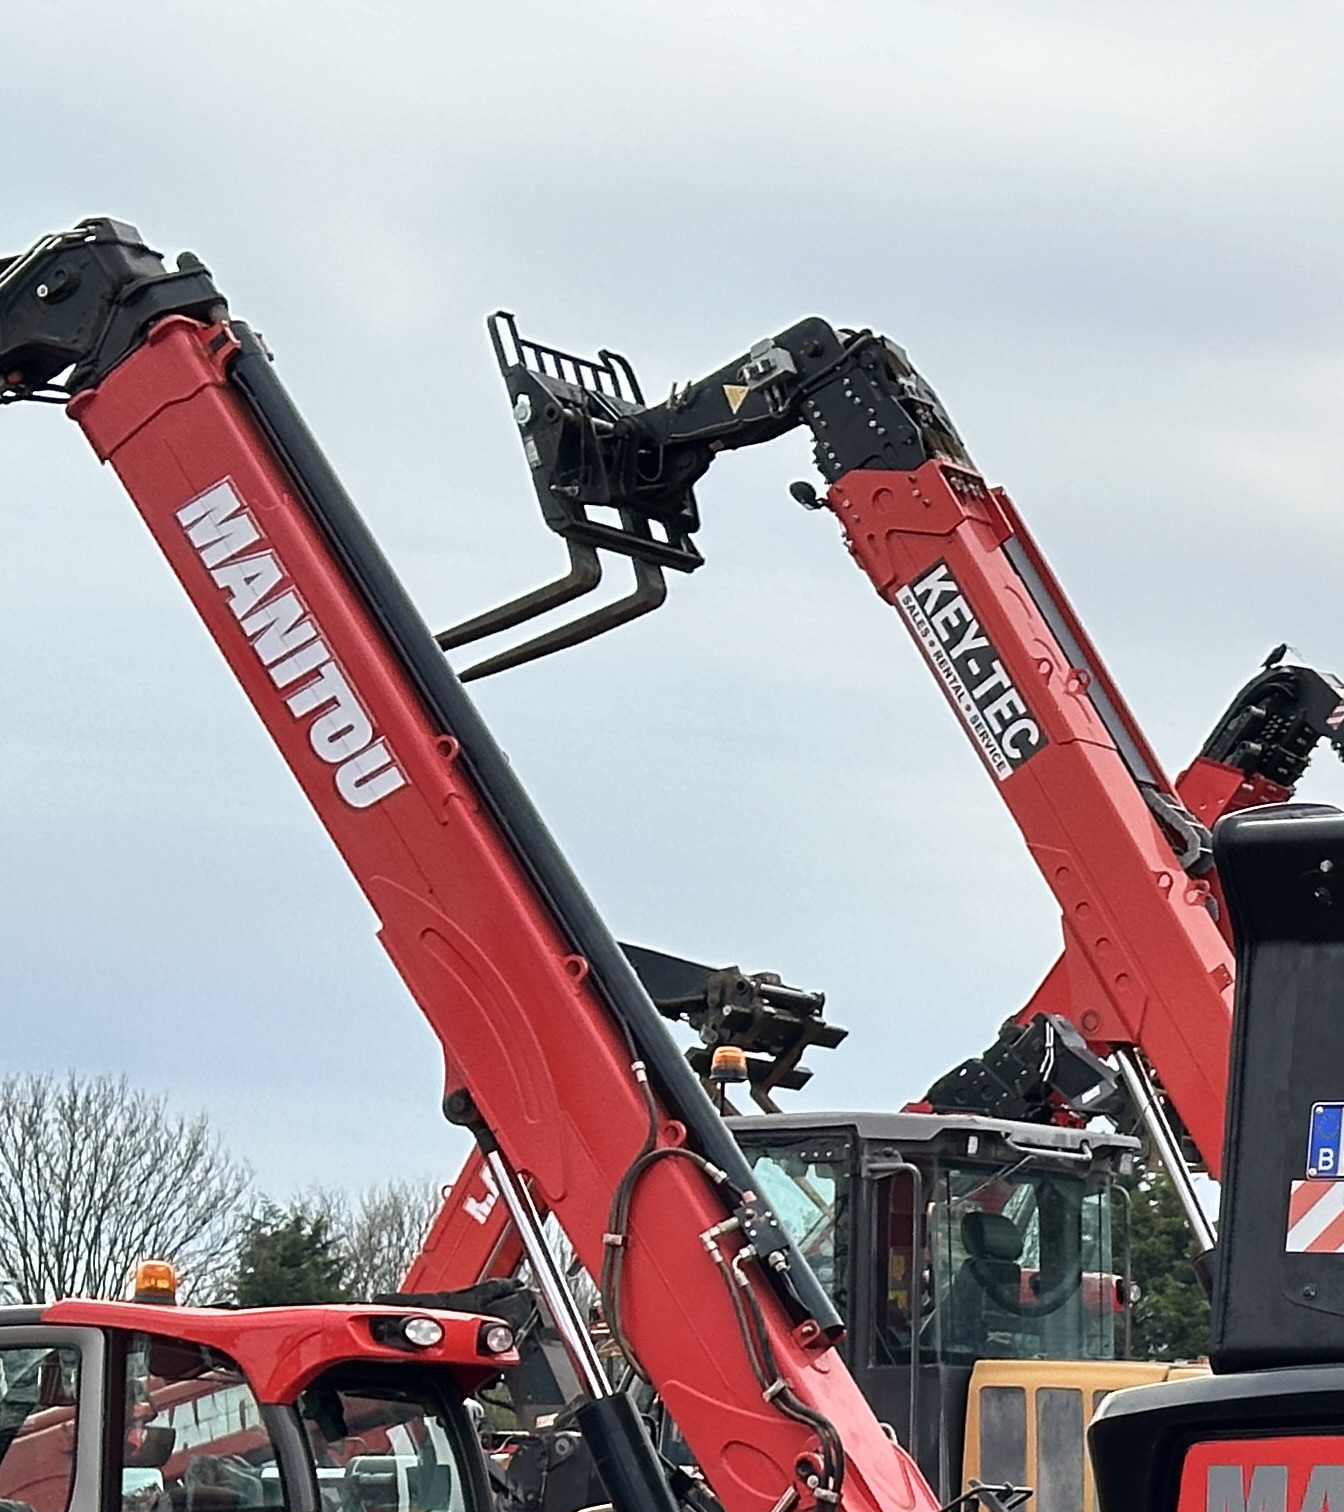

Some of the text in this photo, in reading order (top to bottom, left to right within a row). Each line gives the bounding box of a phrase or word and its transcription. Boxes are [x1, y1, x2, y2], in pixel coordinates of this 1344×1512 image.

[175, 477, 410, 810] MANITOU
[901, 595, 1007, 773] SALES RENTAL SERVICE
[913, 564, 1040, 759] KEY-TEC
[1318, 1148, 1334, 1171] B
